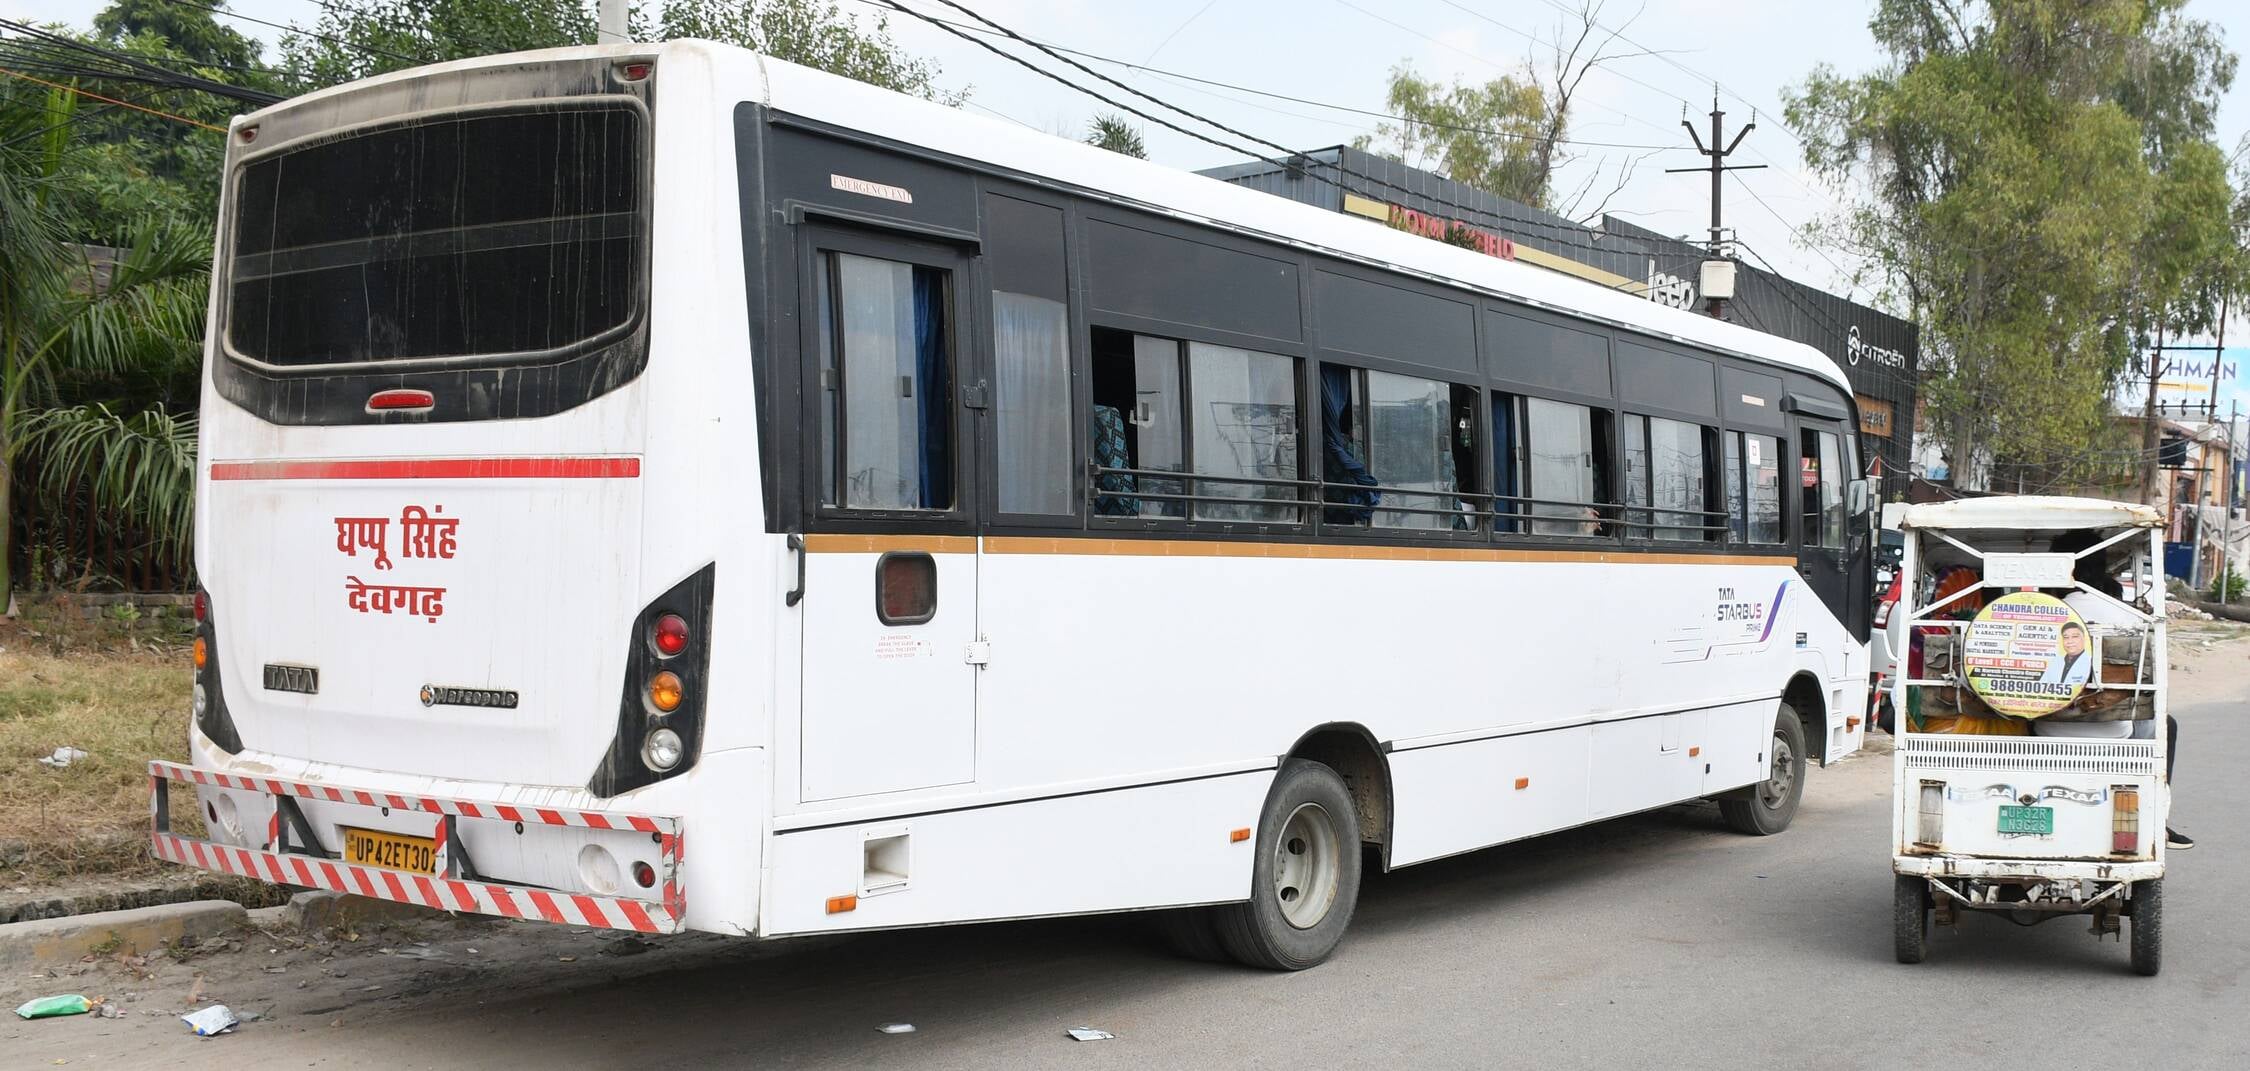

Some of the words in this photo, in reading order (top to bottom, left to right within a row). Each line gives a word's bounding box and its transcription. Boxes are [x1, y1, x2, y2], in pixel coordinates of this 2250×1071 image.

[832, 175, 888, 197] EMERGENCY
[1453, 218, 1514, 260] EFIELD
[1647, 259, 1694, 311] Jeep
[400, 505, 459, 559] सिंह
[345, 576, 447, 623] देवगढ़
[1718, 588, 1735, 600] TATA
[1717, 603, 1762, 621] STARBUS
[1991, 603, 2032, 614] CHANDRA
[2034, 605, 2069, 616] COLLEGE
[267, 667, 317, 692] TATA
[1990, 679, 2073, 696] 9889007455
[435, 688, 517, 706] Marcopolo
[2042, 788, 2102, 802] TEXAA
[2008, 807, 2046, 819] UP32R
[357, 837, 436, 873] UP42ET302
